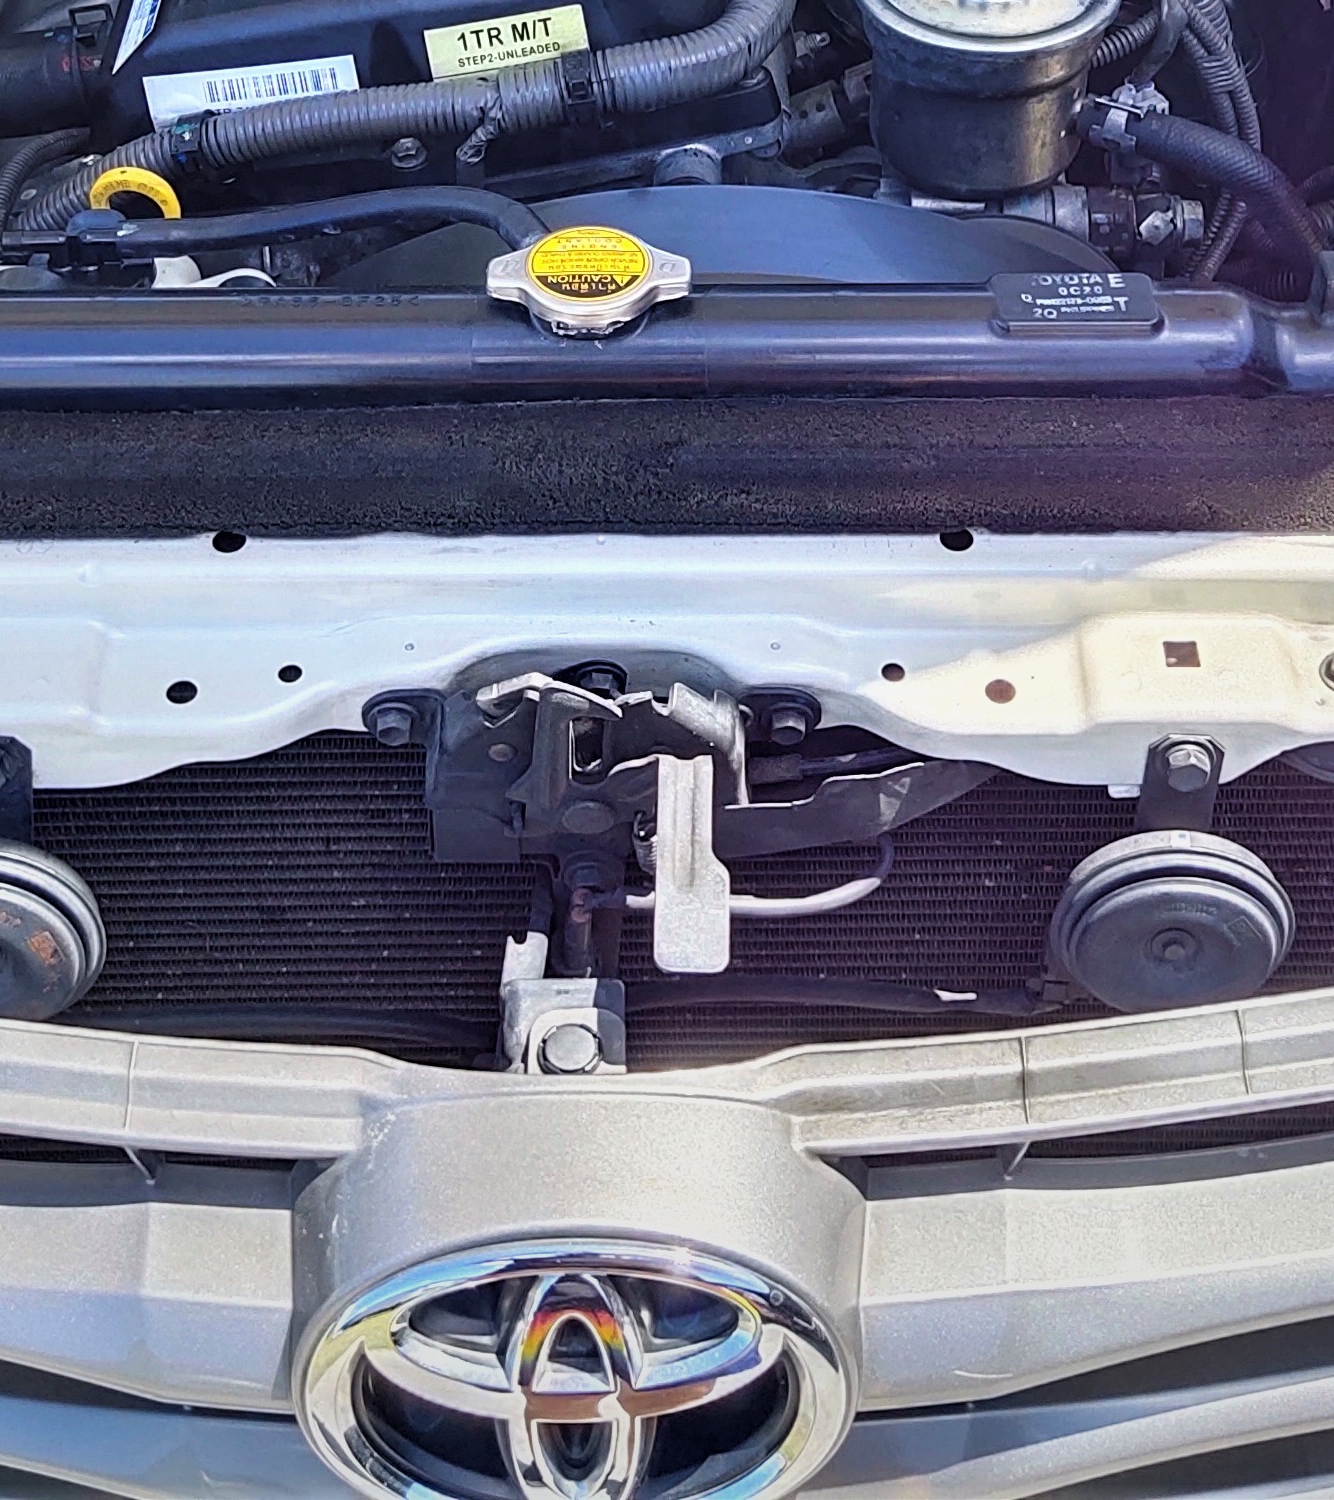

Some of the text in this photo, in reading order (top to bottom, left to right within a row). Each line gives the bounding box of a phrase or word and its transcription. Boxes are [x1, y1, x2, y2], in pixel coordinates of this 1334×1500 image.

[456, 17, 552, 51] 1TR M/T
[457, 41, 561, 68] STEP2-UNLEADED
[547, 275, 612, 283] CAUTION
[1107, 273, 1126, 287] E
[1113, 296, 1129, 312] T
